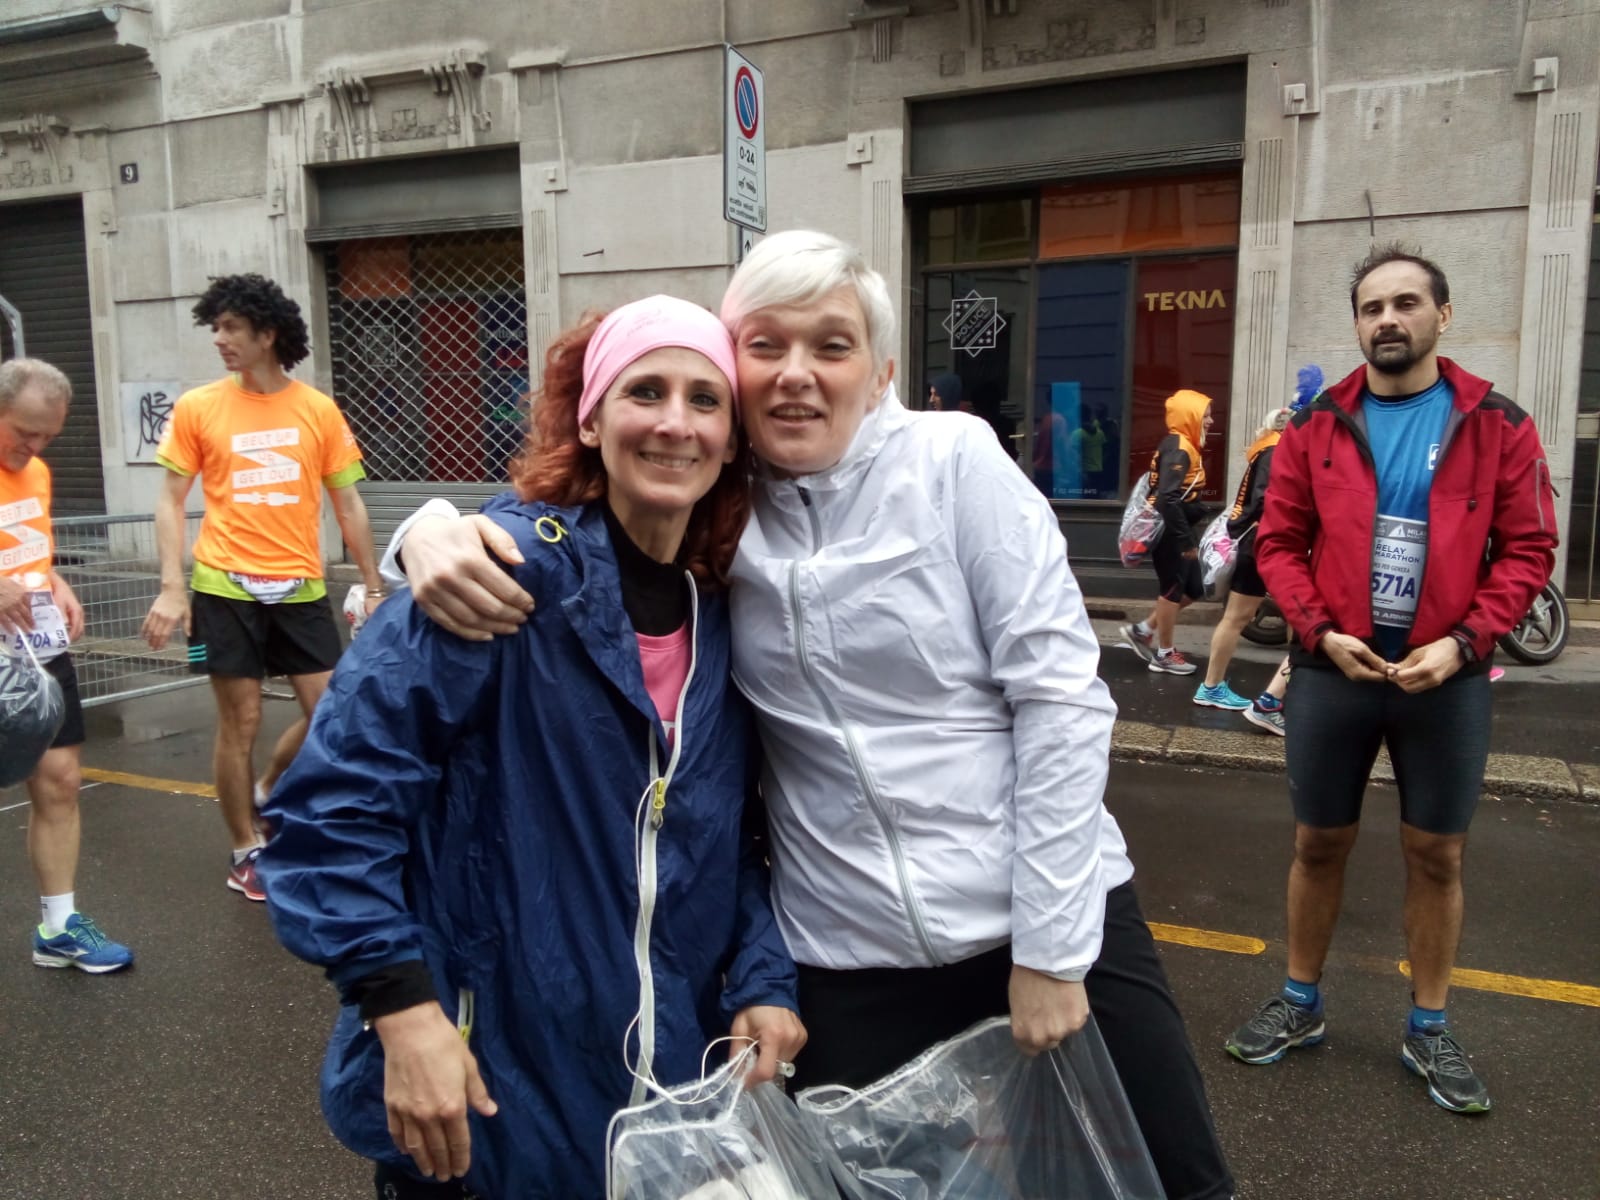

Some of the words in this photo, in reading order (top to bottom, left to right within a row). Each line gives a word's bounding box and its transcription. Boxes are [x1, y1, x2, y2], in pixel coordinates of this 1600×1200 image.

[739, 146, 755, 165] 0-24
[124, 165, 134, 181] 9
[1144, 289, 1226, 311] TEKNA
[240, 434, 272, 447] BELT
[239, 471, 263, 484] GET
[270, 467, 294, 480] OUT
[24, 543, 46, 559] OUT
[1376, 543, 1406, 554] RELAY
[1375, 551, 1420, 564] MARATHON
[1371, 572, 1416, 599] 571A
